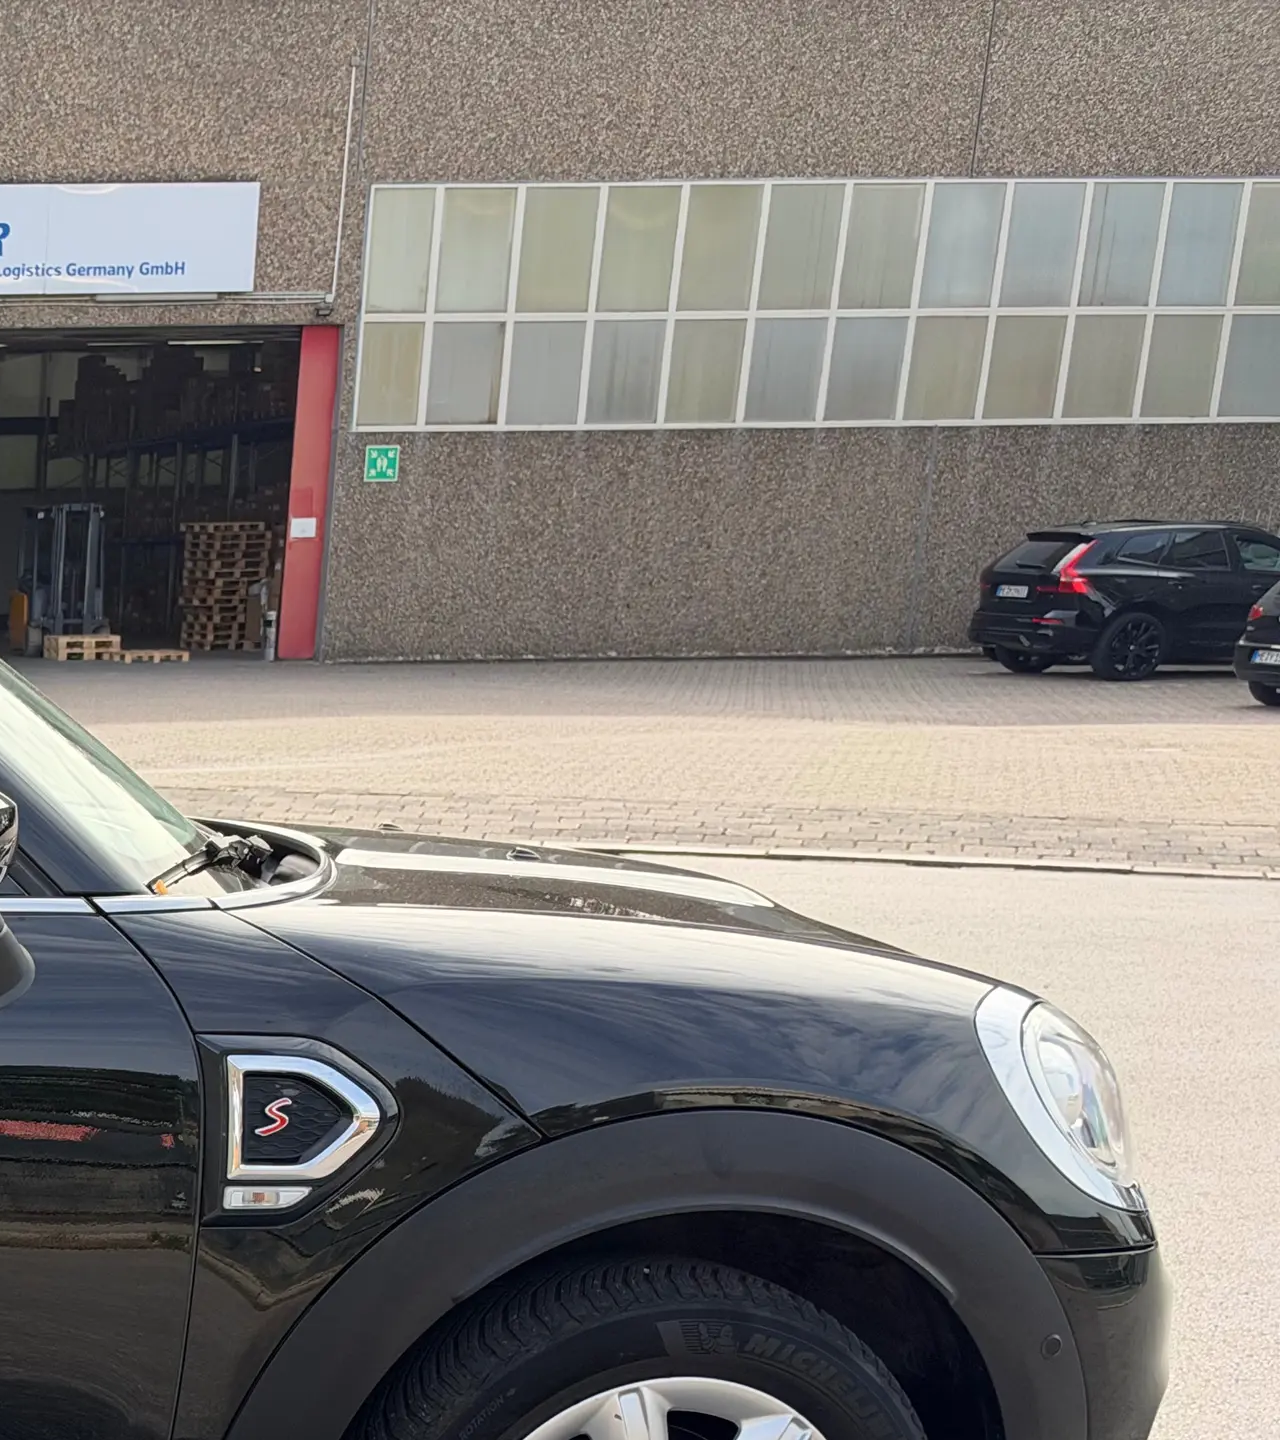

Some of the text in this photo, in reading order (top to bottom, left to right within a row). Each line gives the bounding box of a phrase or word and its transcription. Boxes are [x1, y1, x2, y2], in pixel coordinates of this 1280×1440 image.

[66, 262, 134, 279] Germany
[139, 261, 186, 276] GmbH
[254, 1097, 293, 1137] S
